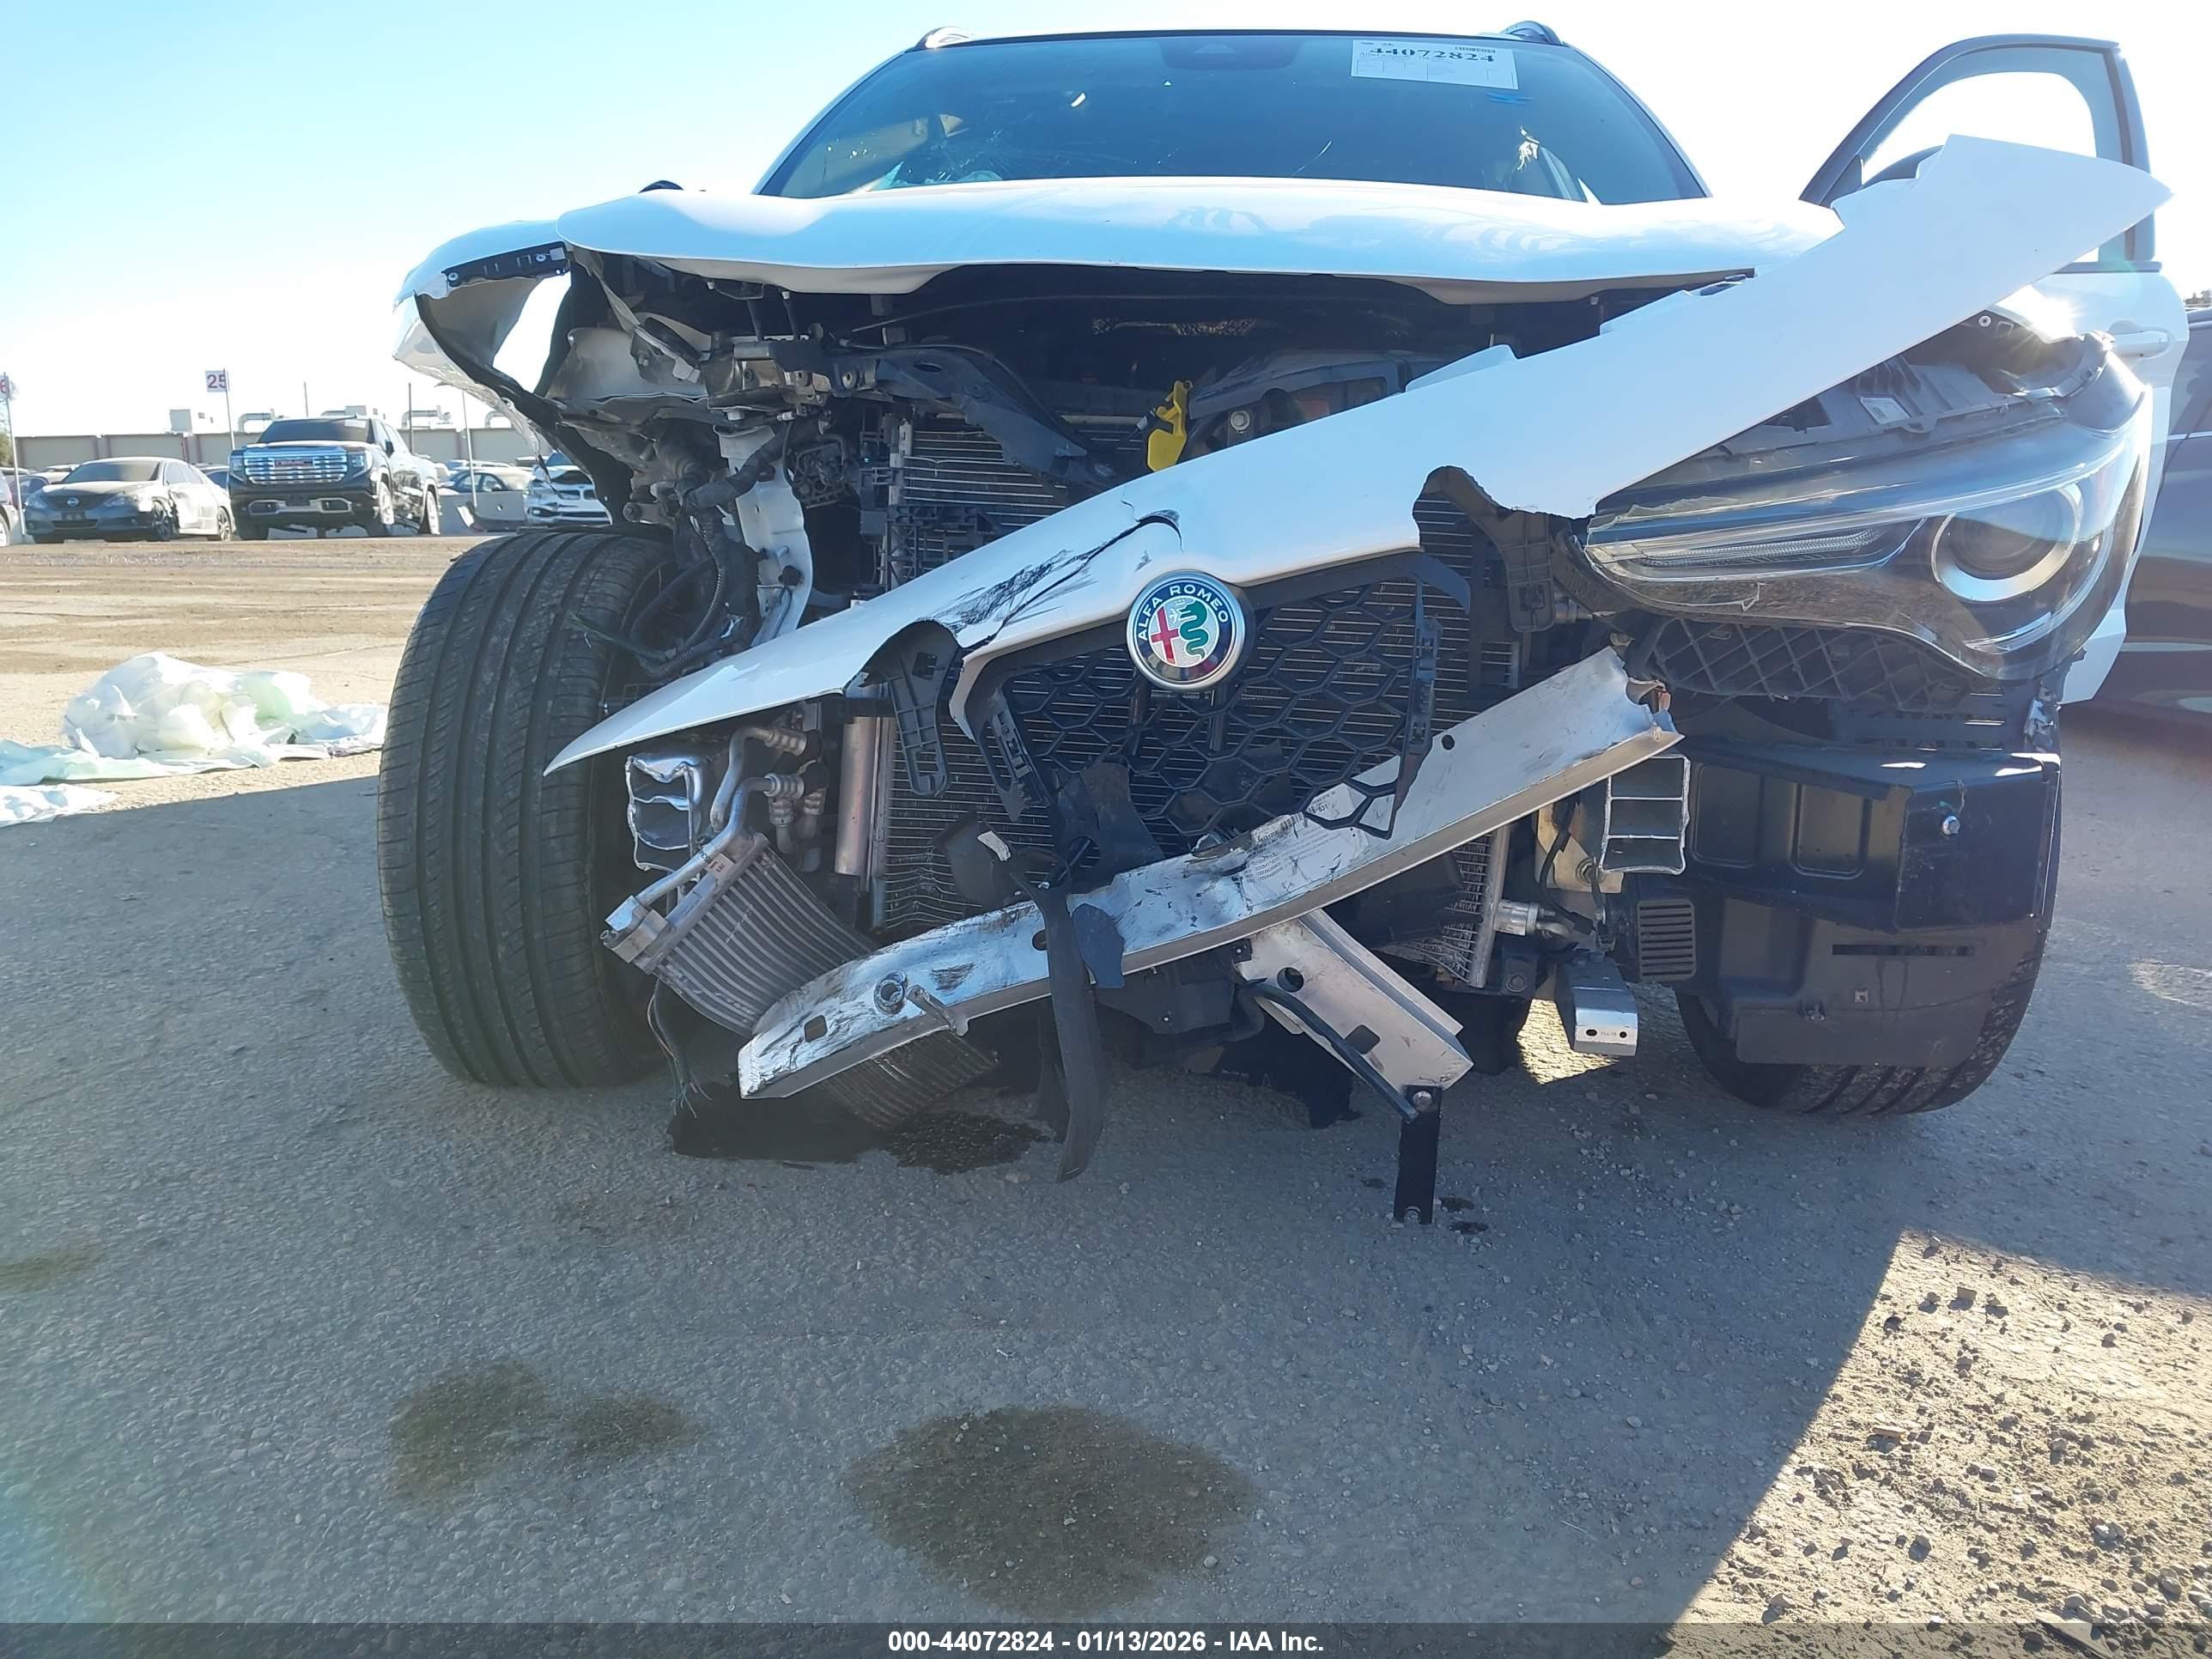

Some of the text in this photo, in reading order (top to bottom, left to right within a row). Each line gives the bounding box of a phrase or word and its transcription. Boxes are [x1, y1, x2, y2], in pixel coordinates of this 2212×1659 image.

[1369, 47, 1495, 62] 44072824
[207, 374, 227, 389] 25
[1138, 584, 1229, 641] ALFA ROMEO
